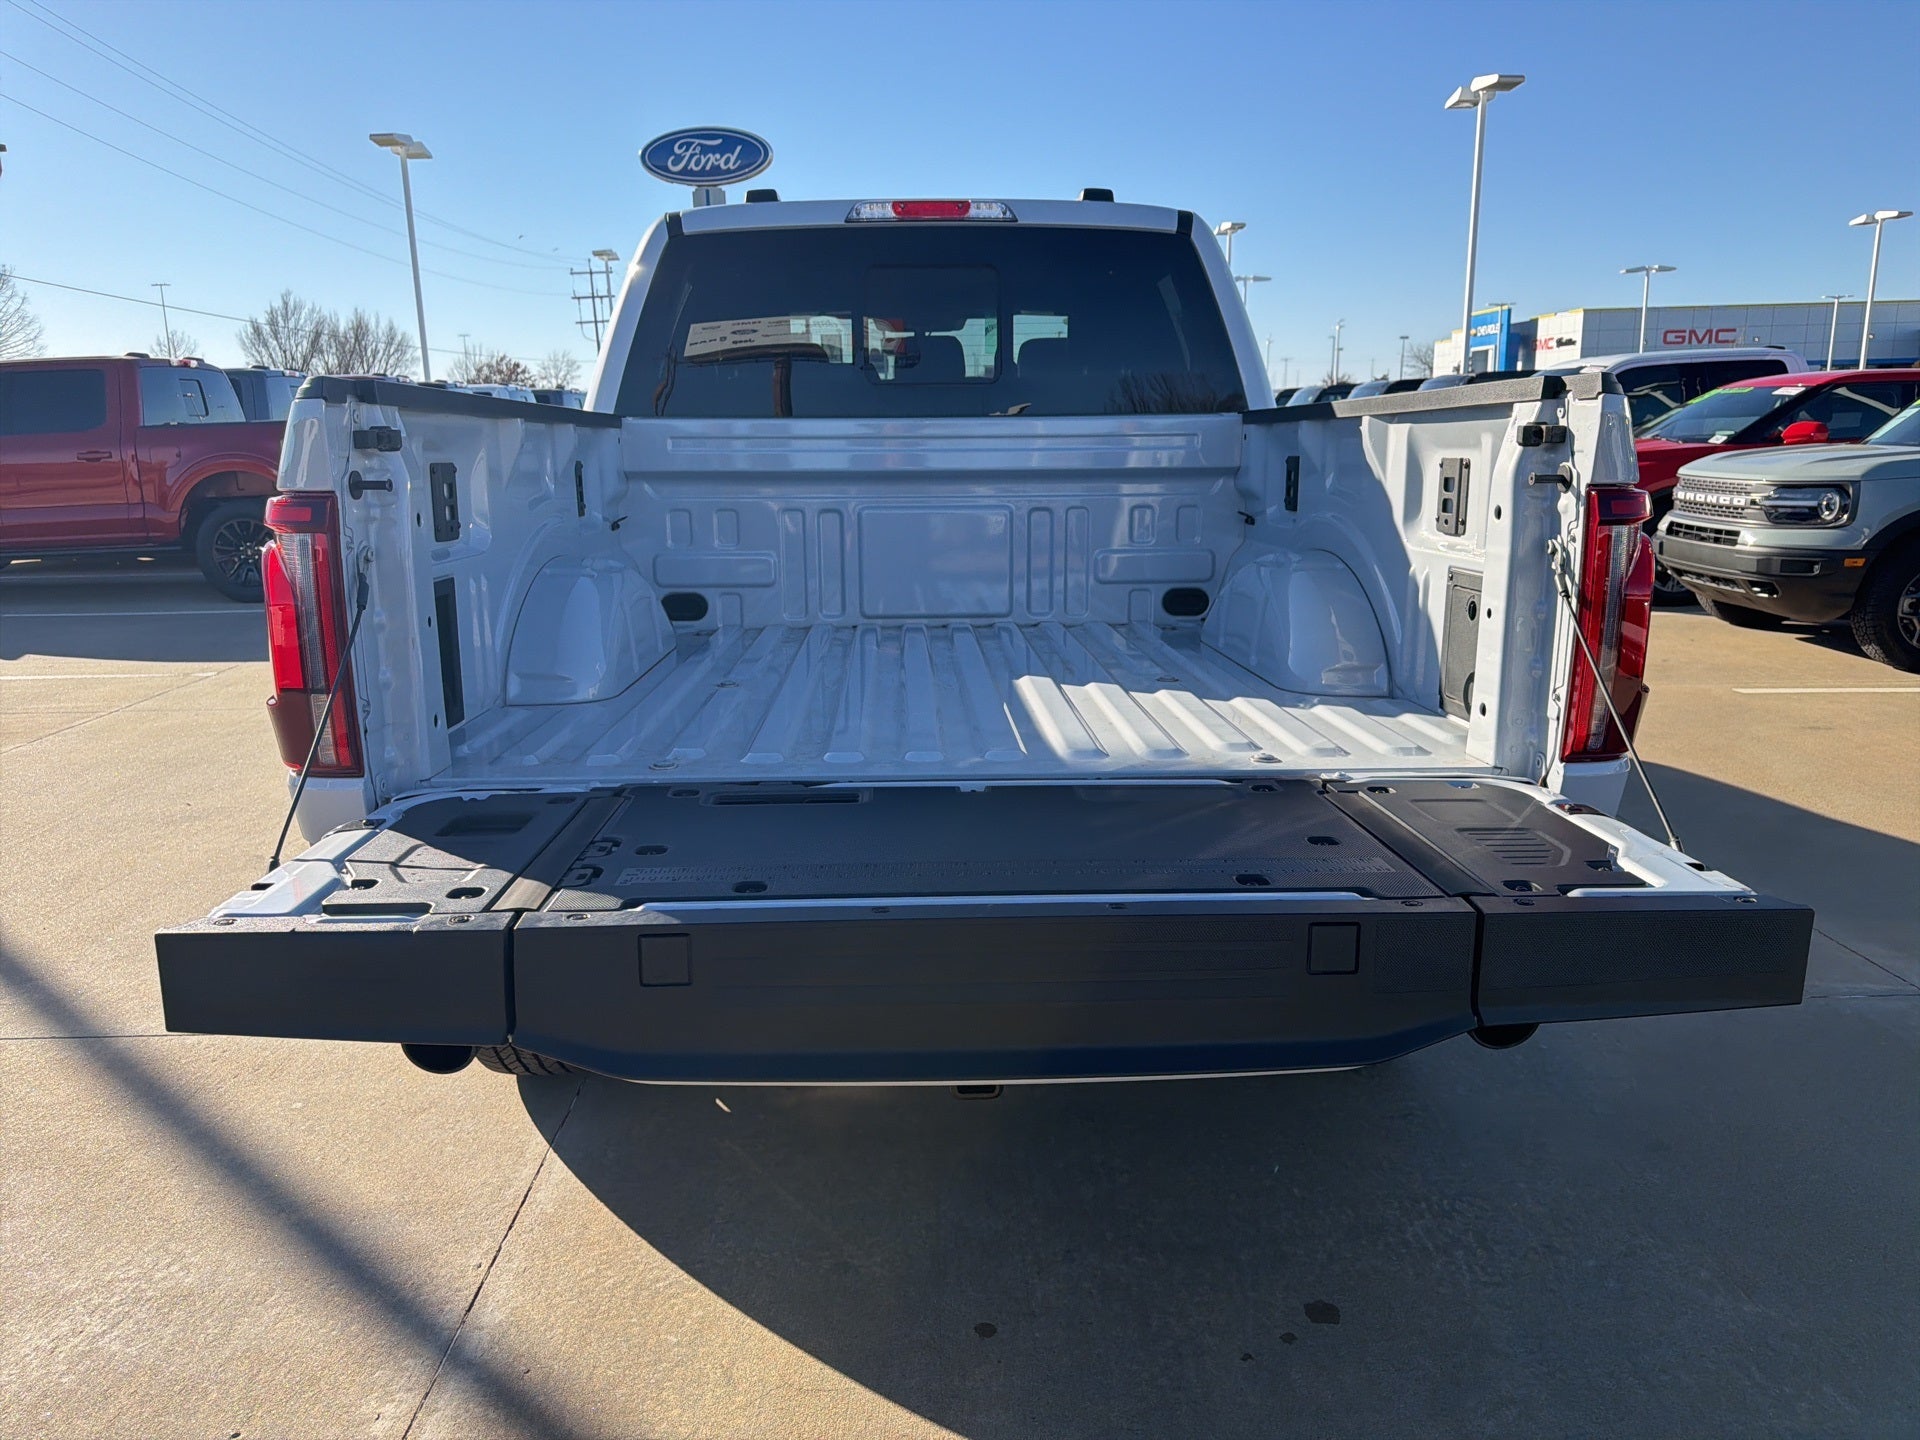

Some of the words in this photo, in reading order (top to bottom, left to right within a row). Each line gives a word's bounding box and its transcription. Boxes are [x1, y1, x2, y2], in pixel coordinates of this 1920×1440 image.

[667, 138, 744, 172] Ford
[1662, 327, 1738, 345] GMC
[1532, 337, 1555, 352] GMC
[1677, 491, 1746, 506] BRONCO
